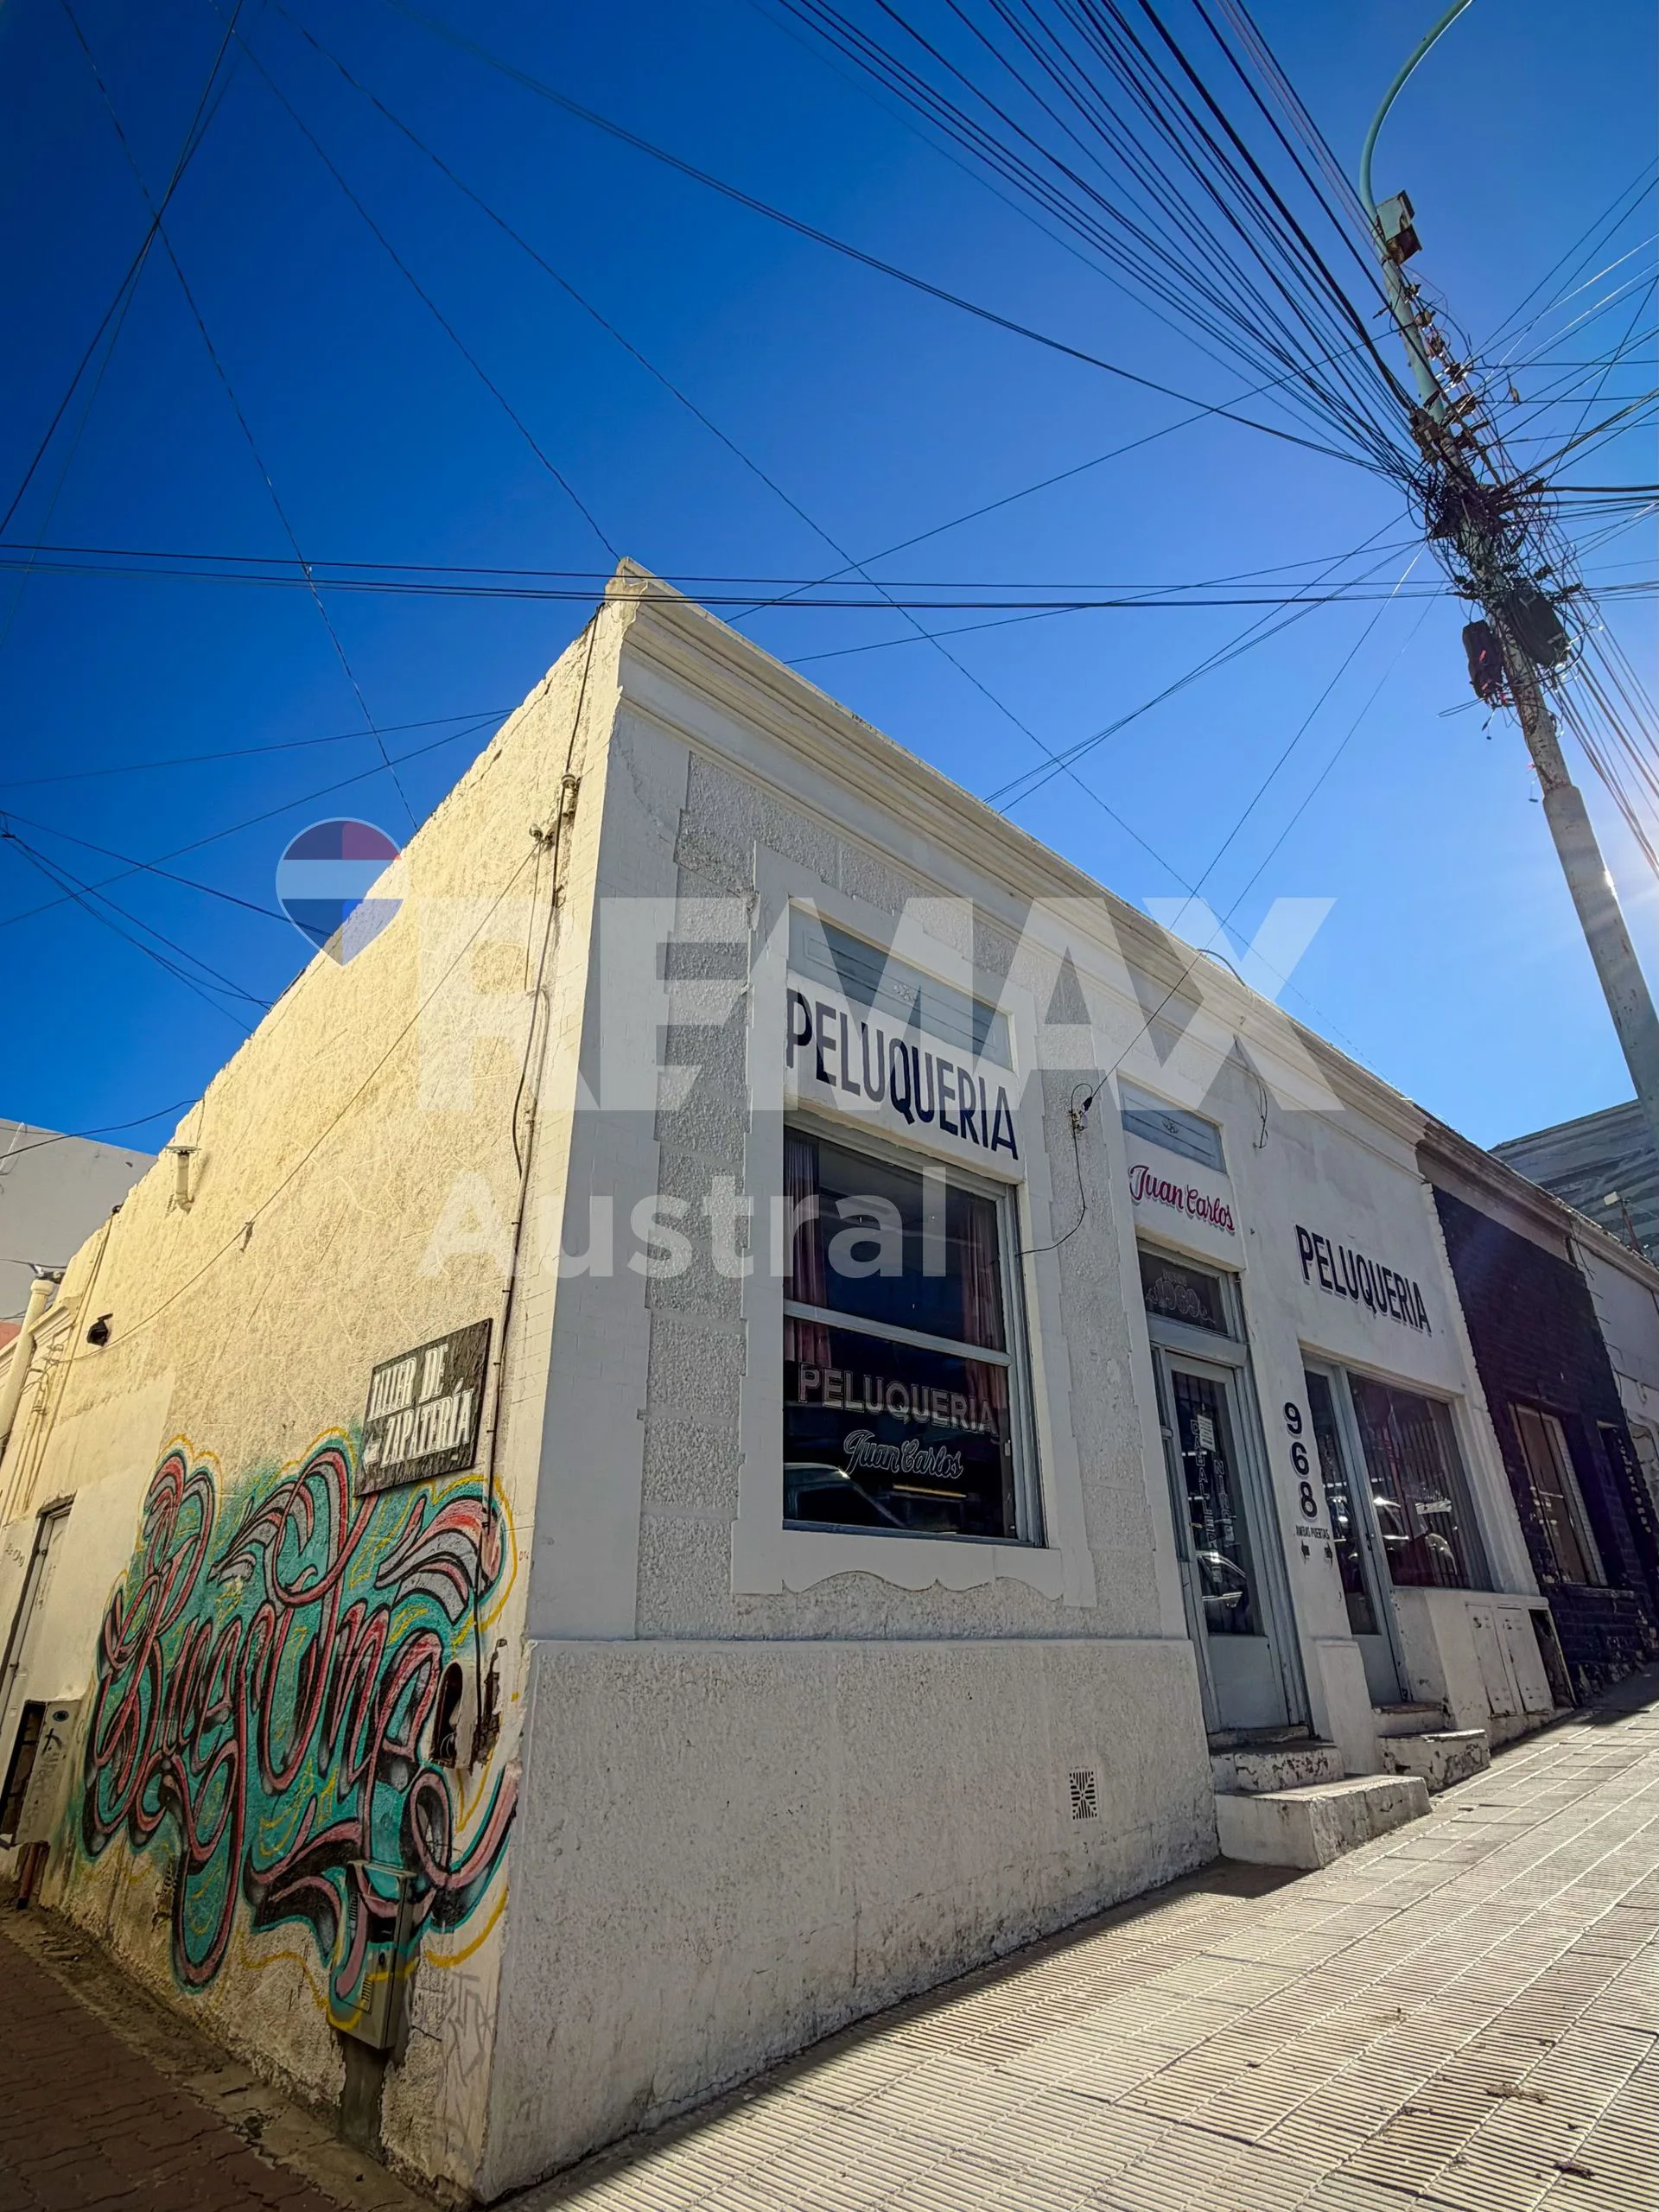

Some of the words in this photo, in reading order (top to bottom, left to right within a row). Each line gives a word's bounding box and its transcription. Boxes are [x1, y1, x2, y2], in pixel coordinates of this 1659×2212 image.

[785, 988, 1019, 1161] PELUQUERIA
[1129, 1165, 1184, 1211] Juan
[1185, 1185, 1236, 1235] Carlos
[1294, 1224, 1433, 1336] PELUQUERIA
[367, 1357, 417, 1421] TALLER
[419, 1343, 448, 1403] DE
[798, 1361, 999, 1437] PELUQUERIA
[843, 1429, 899, 1476] Juan
[900, 1439, 963, 1479] Carlos
[1283, 1402, 1319, 1522] 968
